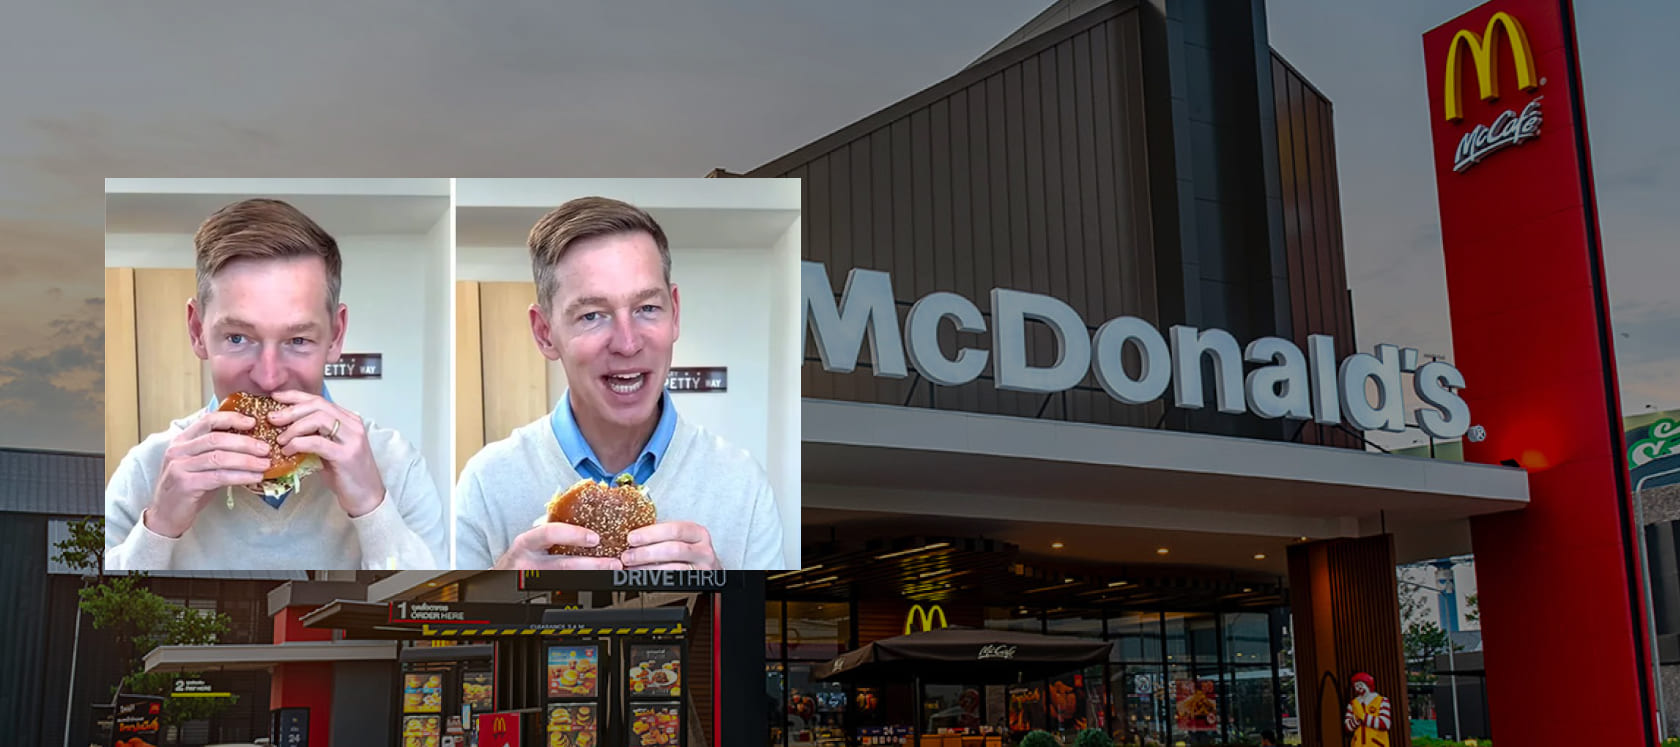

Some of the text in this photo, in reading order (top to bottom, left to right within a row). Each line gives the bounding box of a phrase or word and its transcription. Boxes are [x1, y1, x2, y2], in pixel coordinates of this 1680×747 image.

[801, 261, 1471, 439] McDonald's
[324, 363, 355, 376] ETTY
[397, 602, 406, 619] 1
[175, 680, 185, 692] 2
